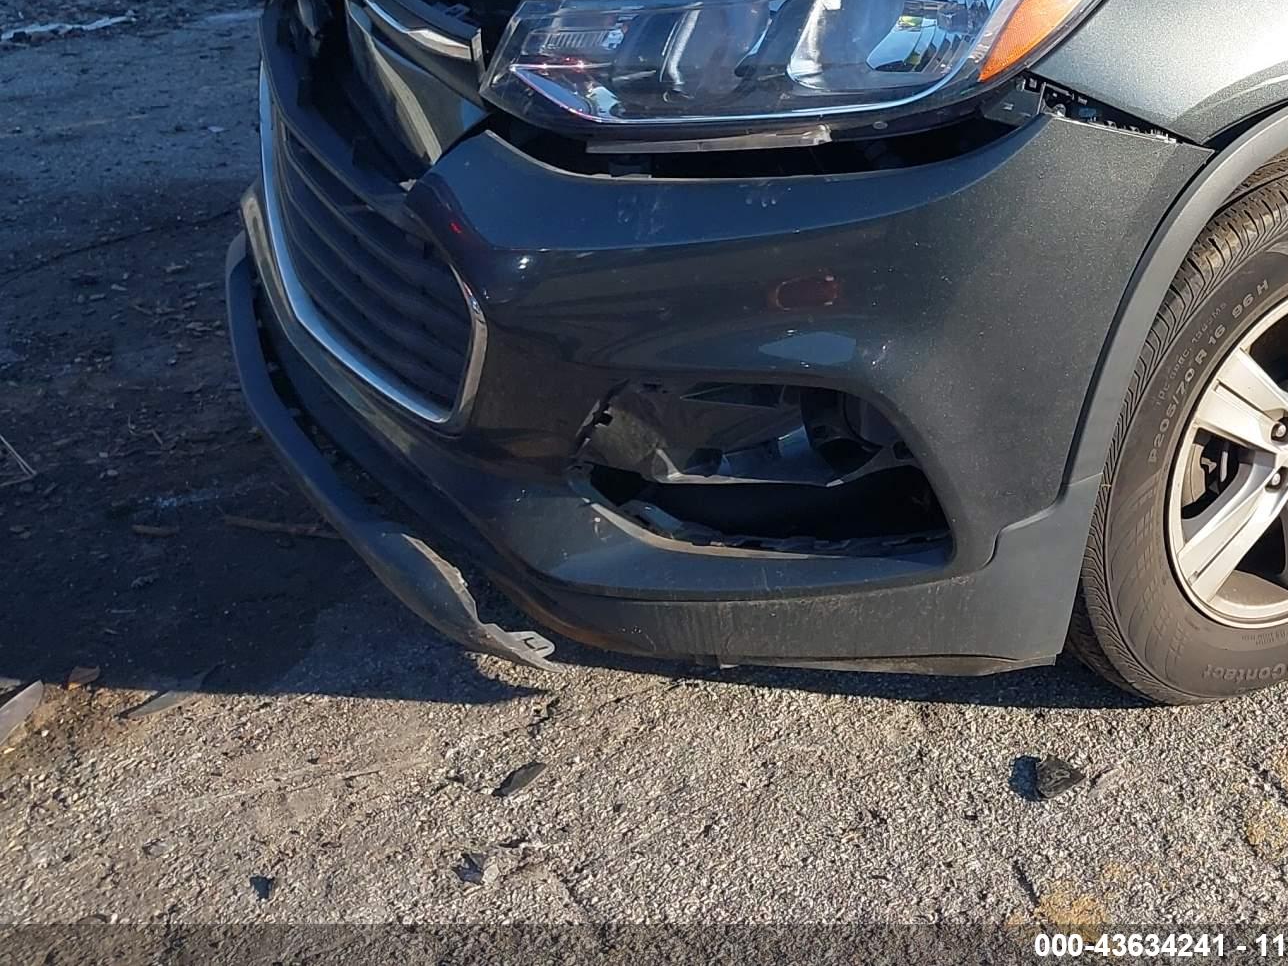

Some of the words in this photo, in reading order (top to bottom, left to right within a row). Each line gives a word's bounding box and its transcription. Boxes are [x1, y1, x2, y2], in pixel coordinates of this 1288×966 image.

[1148, 367, 1195, 464] P205/70
[1195, 348, 1208, 365] R
[1208, 324, 1227, 346] 16
[1232, 293, 1254, 319] 96
[1256, 279, 1270, 295] H
